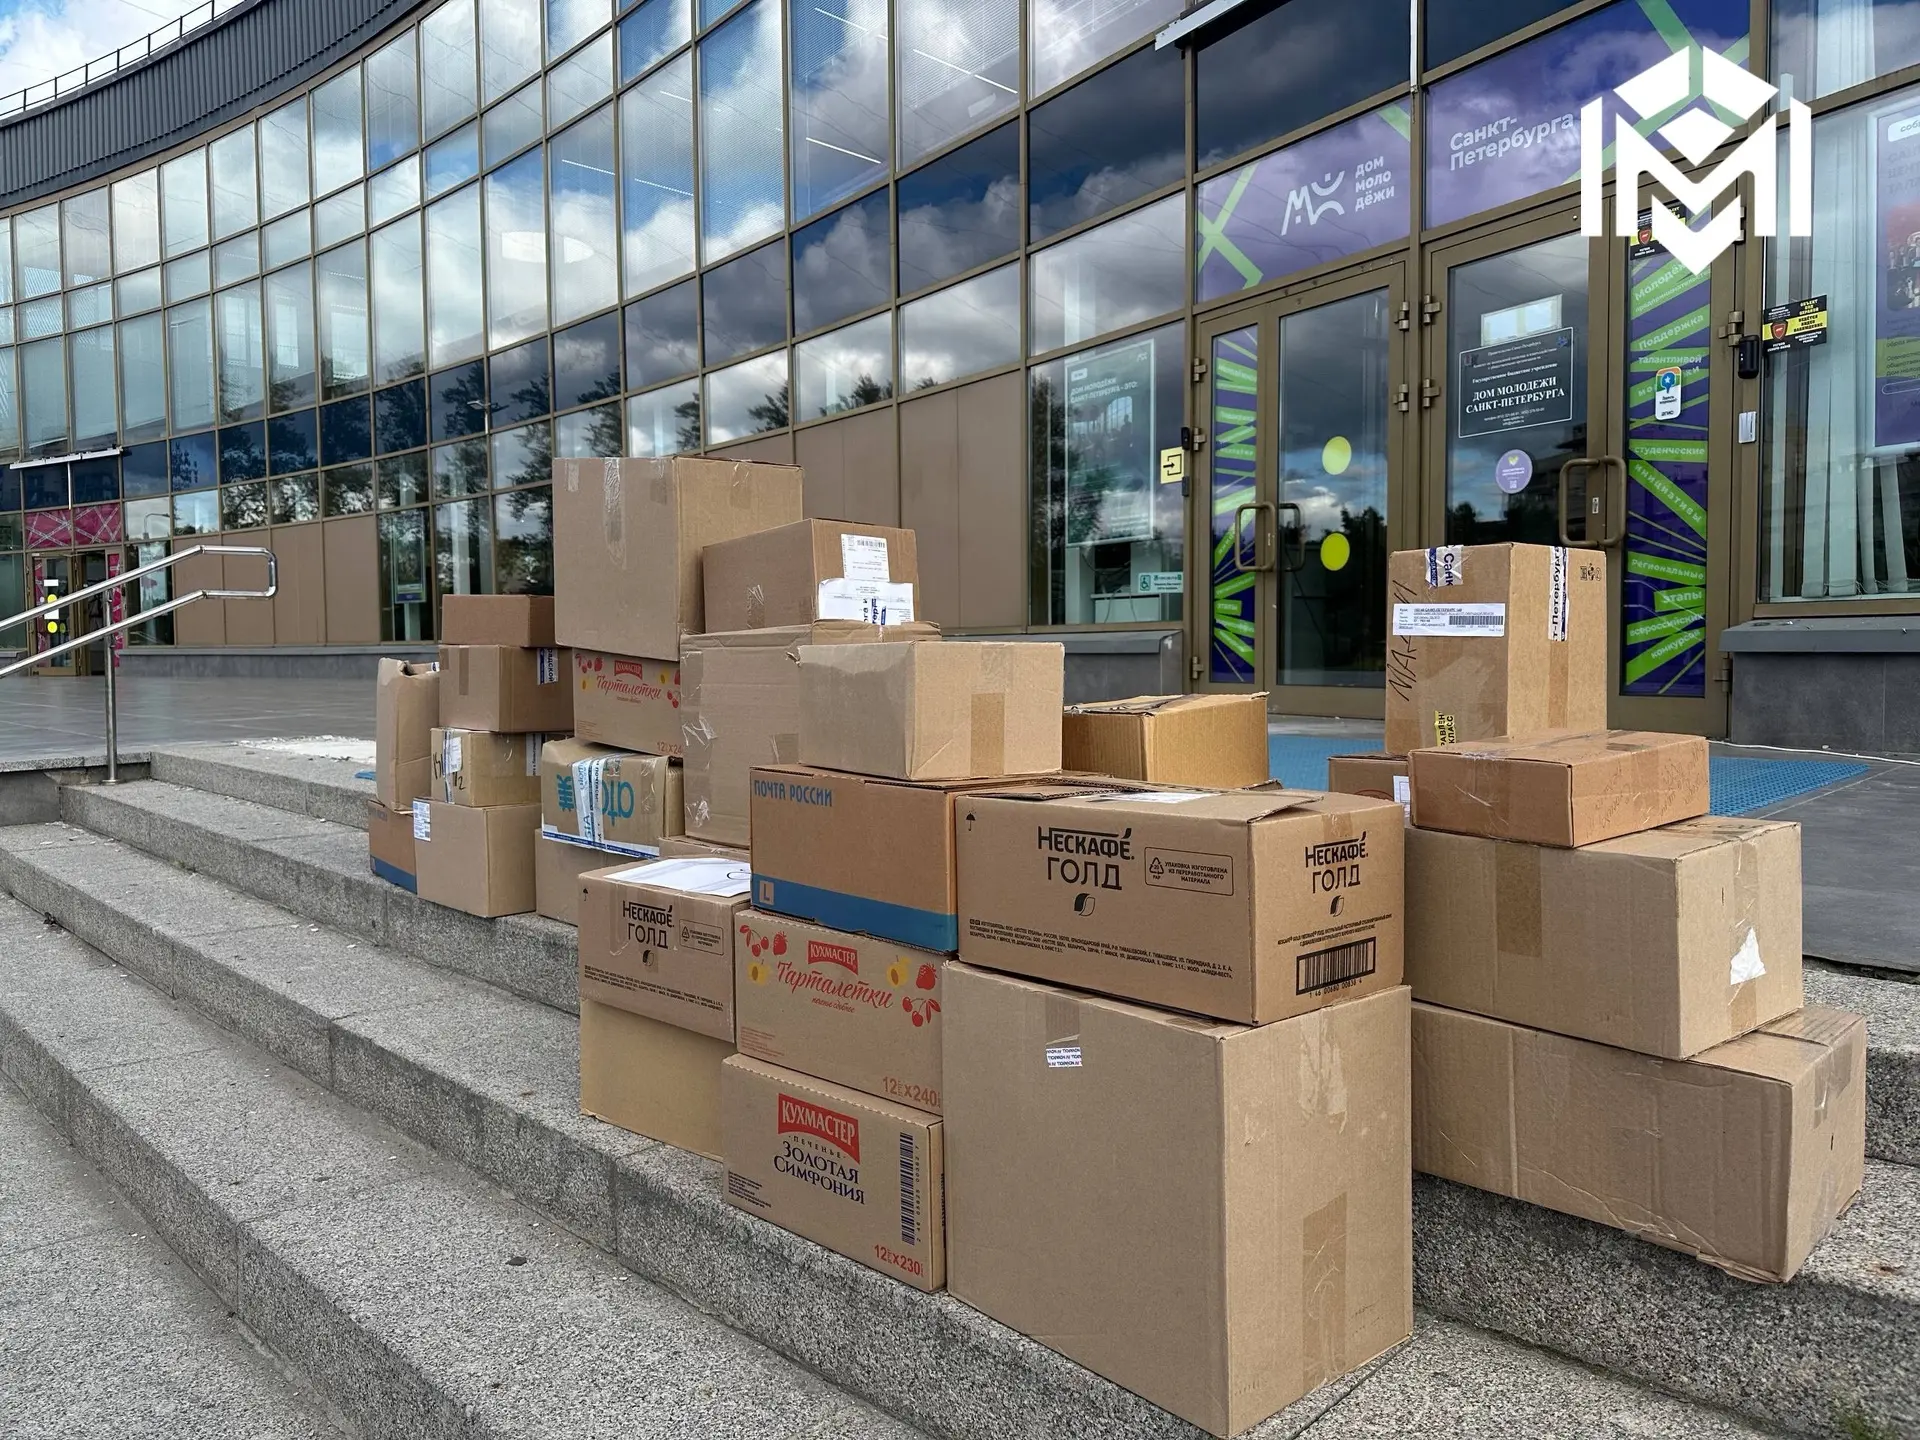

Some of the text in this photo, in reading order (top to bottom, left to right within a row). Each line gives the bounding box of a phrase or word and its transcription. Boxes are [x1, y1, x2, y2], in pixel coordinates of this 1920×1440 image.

[1450, 116, 1517, 151] Санкт-
[1450, 113, 1574, 171] Петербурга
[1638, 313, 1704, 350] Поддержка
[1638, 354, 1702, 364] талантливой
[1465, 388, 1565, 414] САНКТ-ПЕТЕРБУРГА
[1472, 376, 1557, 402] ДОМ МОЛОДЕЖИ
[1634, 446, 1705, 456] студенческие
[1634, 463, 1702, 523] инициативы
[1663, 591, 1702, 604] этапы
[596, 675, 661, 700] Тарталетки
[1446, 715, 1455, 744] КЛАСС
[754, 779, 833, 807] ПОЧТА РОССИИ
[1047, 856, 1122, 891] ГОЛД
[1164, 861, 1228, 874] УПАКОВКА ИЗГОТОВЛЕНА
[1175, 869, 1225, 880] ПЕРЕРАБОТАННОГО
[1180, 876, 1211, 885] МАТЕРИАЛА
[1312, 864, 1361, 894] ГОЛД
[763, 883, 770, 901] L
[627, 923, 668, 949] ГОЛД
[810, 943, 856, 965] КУХМАСТЕР
[777, 960, 894, 1009] Тарталетки
[781, 1099, 856, 1146] КУХМАСТЕР
[793, 1135, 841, 1159] ПЕЧЕНЬЕ
[782, 1140, 859, 1184] ЗОЛОТАЯ
[773, 1155, 865, 1205] СИМФОНИЯ
